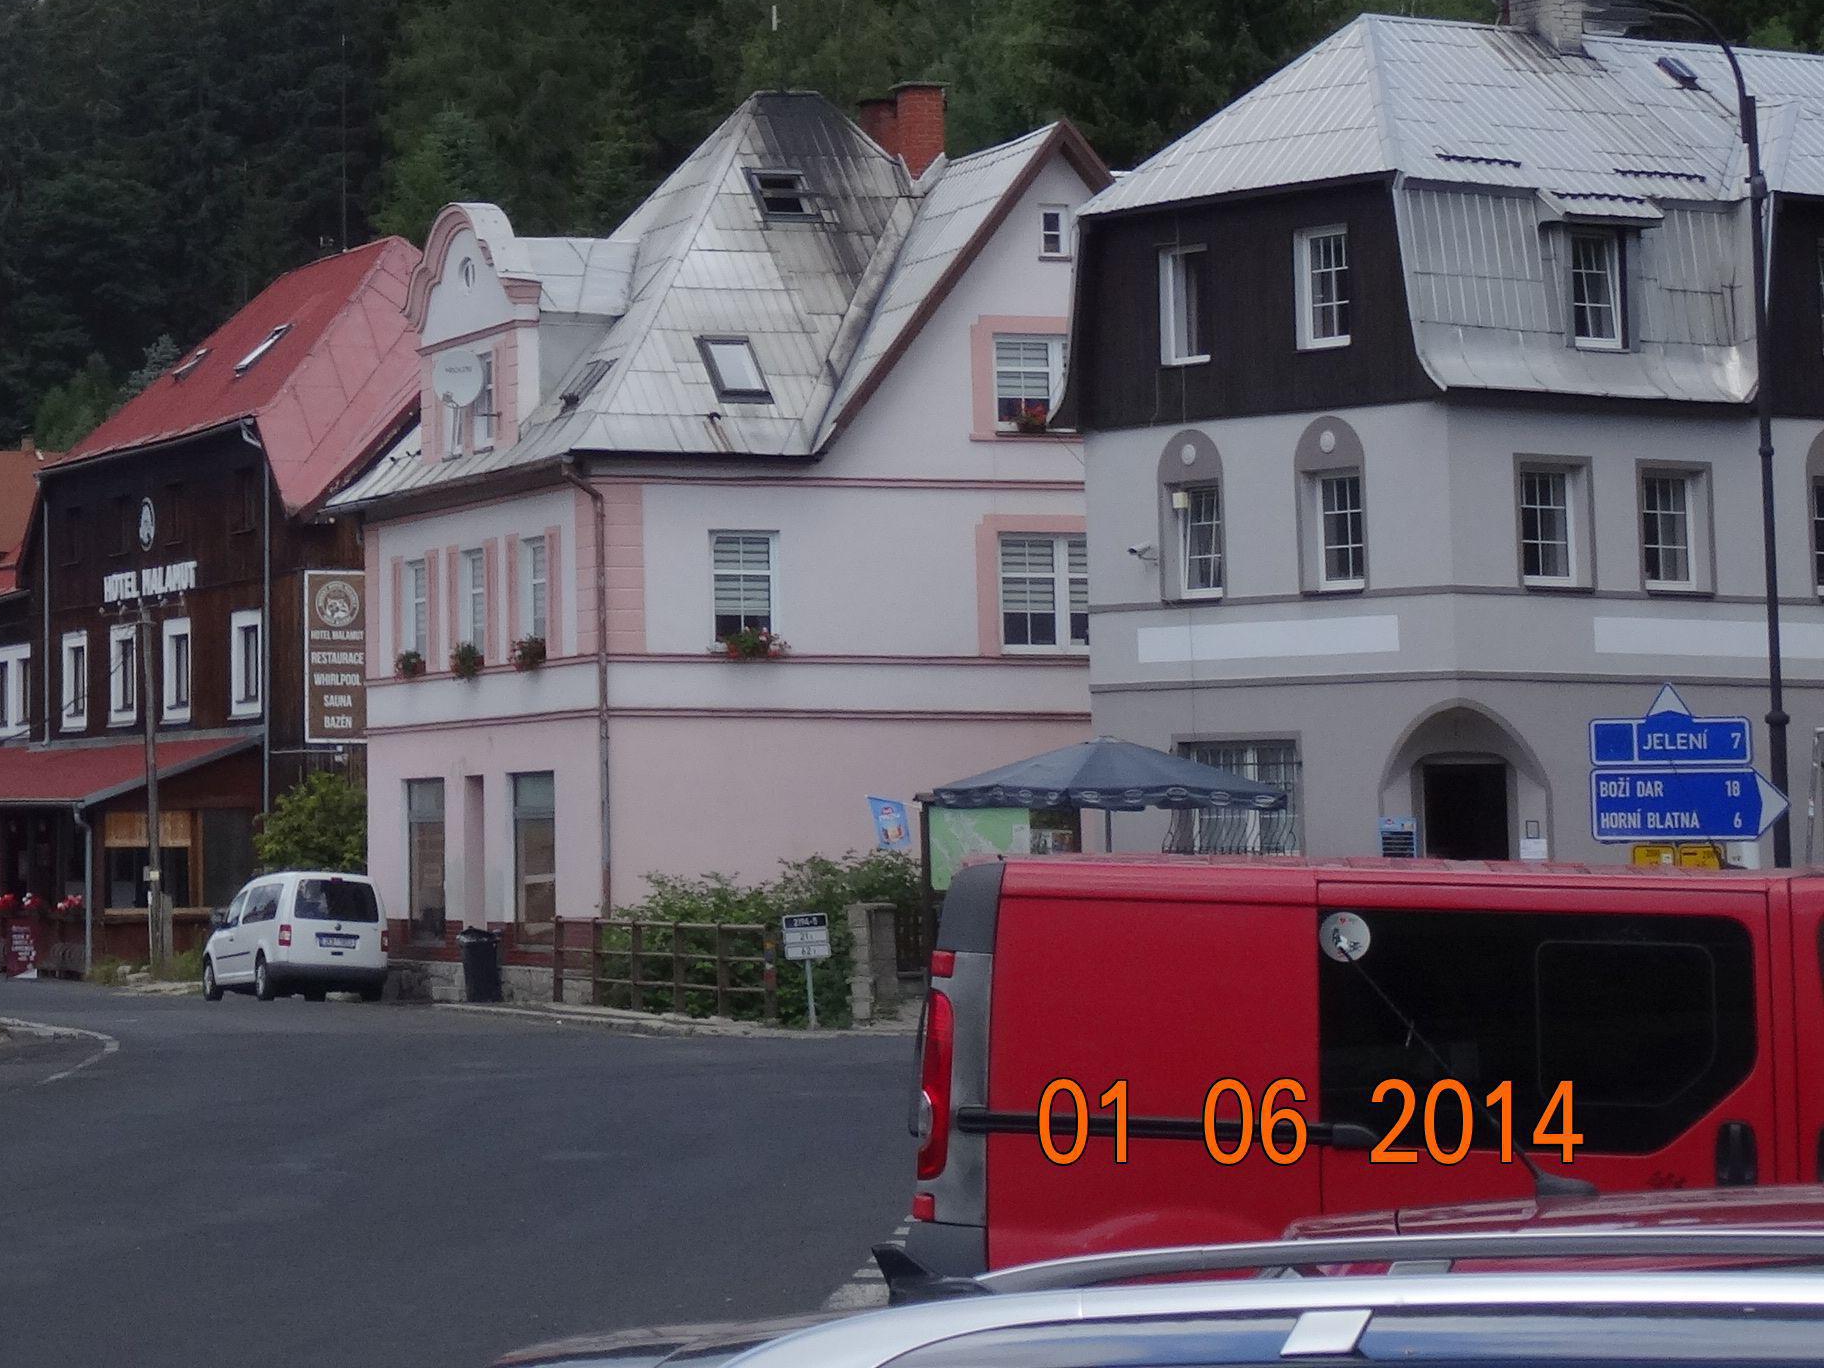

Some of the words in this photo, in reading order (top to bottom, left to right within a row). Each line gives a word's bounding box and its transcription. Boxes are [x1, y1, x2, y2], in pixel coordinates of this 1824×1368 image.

[104, 571, 140, 603] HOTEL
[142, 561, 197, 596] MALAMUT
[311, 652, 364, 664] RESTAURACE
[314, 673, 362, 685] WHIRLPOOL
[323, 695, 352, 707] SAUNA
[324, 714, 352, 728] BAZÉN
[1643, 729, 1707, 750] JELENÍ
[1731, 732, 1741, 749] 7
[1600, 778, 1630, 797] BOŽÍ
[1637, 781, 1664, 797] DAR
[1726, 781, 1741, 797] 18
[1600, 808, 1641, 829] HORNÍ
[1733, 814, 1742, 828] 6
